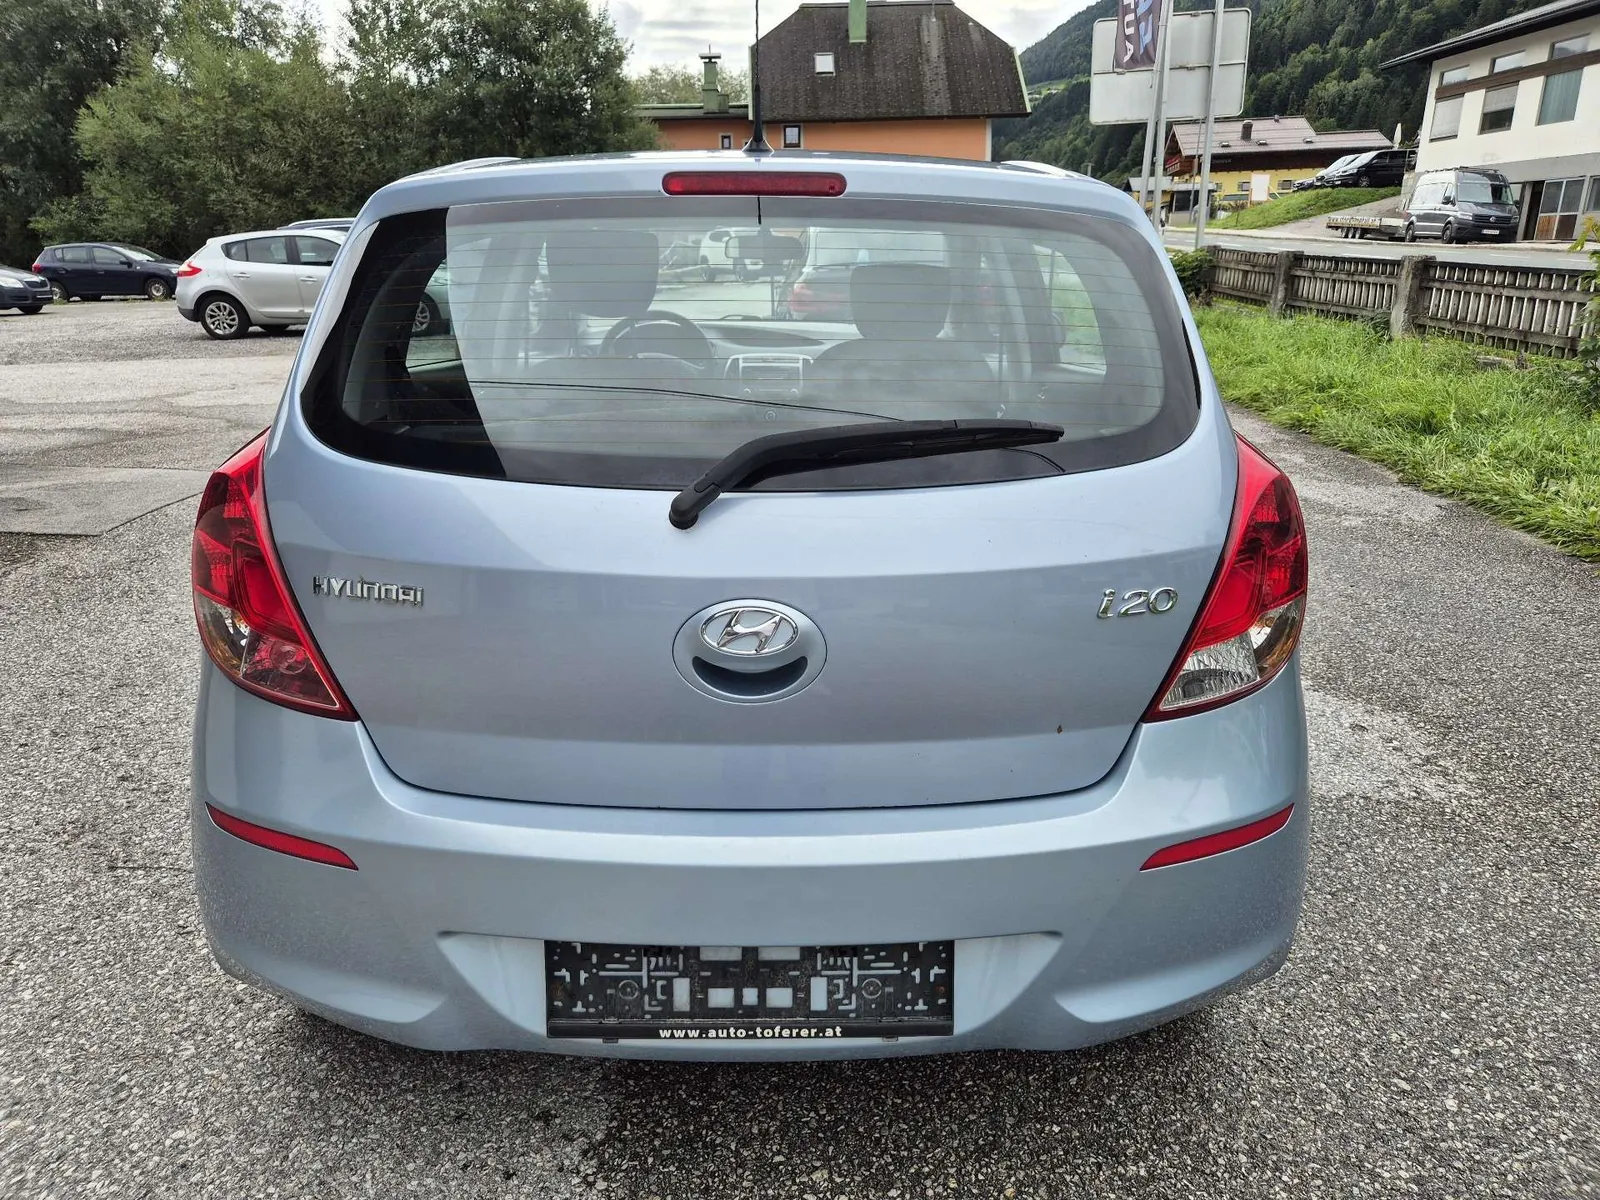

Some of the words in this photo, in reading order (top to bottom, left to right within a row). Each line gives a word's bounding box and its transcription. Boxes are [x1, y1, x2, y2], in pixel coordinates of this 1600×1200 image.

[313, 576, 424, 606] HYUNDAI
[1097, 586, 1178, 619] i20
[658, 1026, 842, 1039] www.auto-toferer.at
